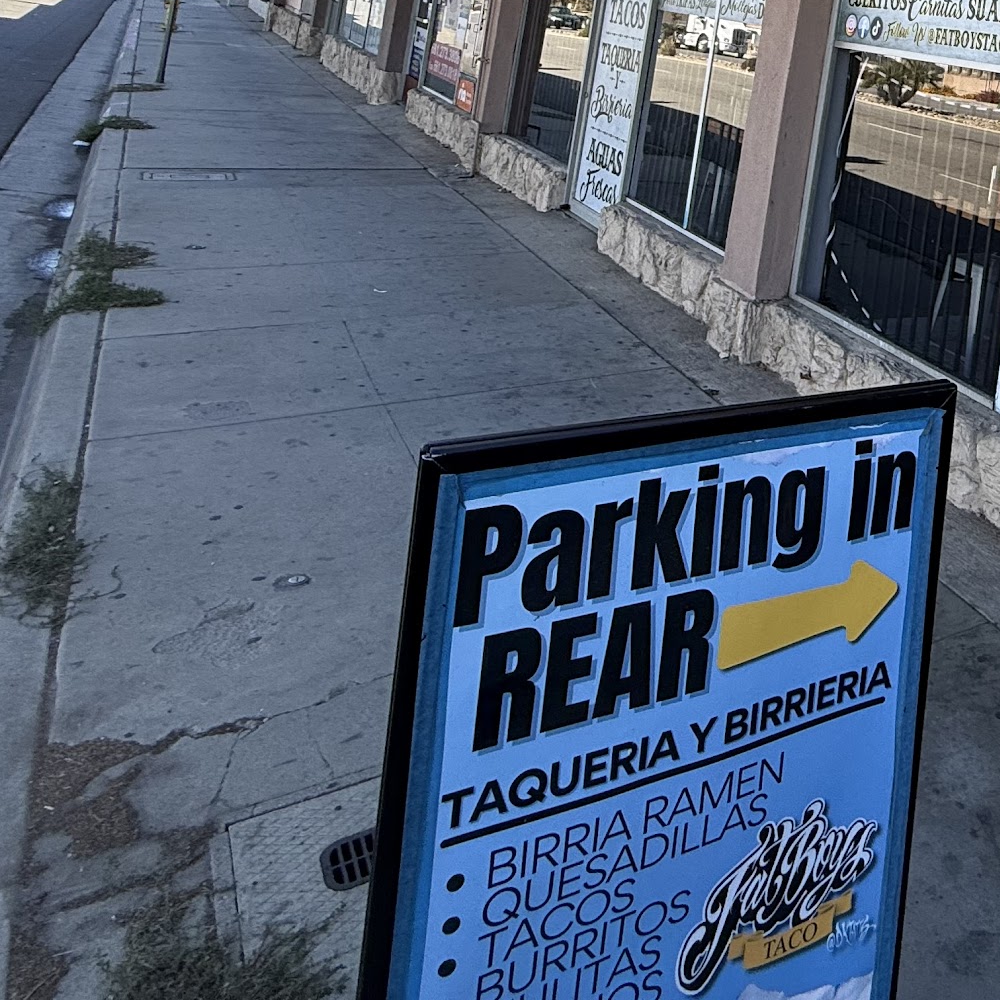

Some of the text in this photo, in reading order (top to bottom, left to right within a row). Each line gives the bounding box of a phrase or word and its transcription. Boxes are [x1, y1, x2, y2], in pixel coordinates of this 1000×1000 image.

[601, 43, 641, 73] TAQUERIA
[883, 20, 909, 41] Follow
[591, 85, 632, 123] Birrieria
[614, 70, 621, 89] Y
[580, 169, 618, 205] Frescas
[586, 138, 624, 176] AGUAS
[453, 439, 918, 628] Parking in
[472, 589, 715, 753] REAR
[442, 661, 892, 829] TAQUERIA Y BIRRIERIA
[488, 752, 785, 889] BIRRIA RAMEN
[482, 794, 769, 927] QUESADILLAS
[476, 890, 691, 1000] BURRITOS
[478, 878, 636, 968] TACOS
[764, 921, 818, 960] TACO
